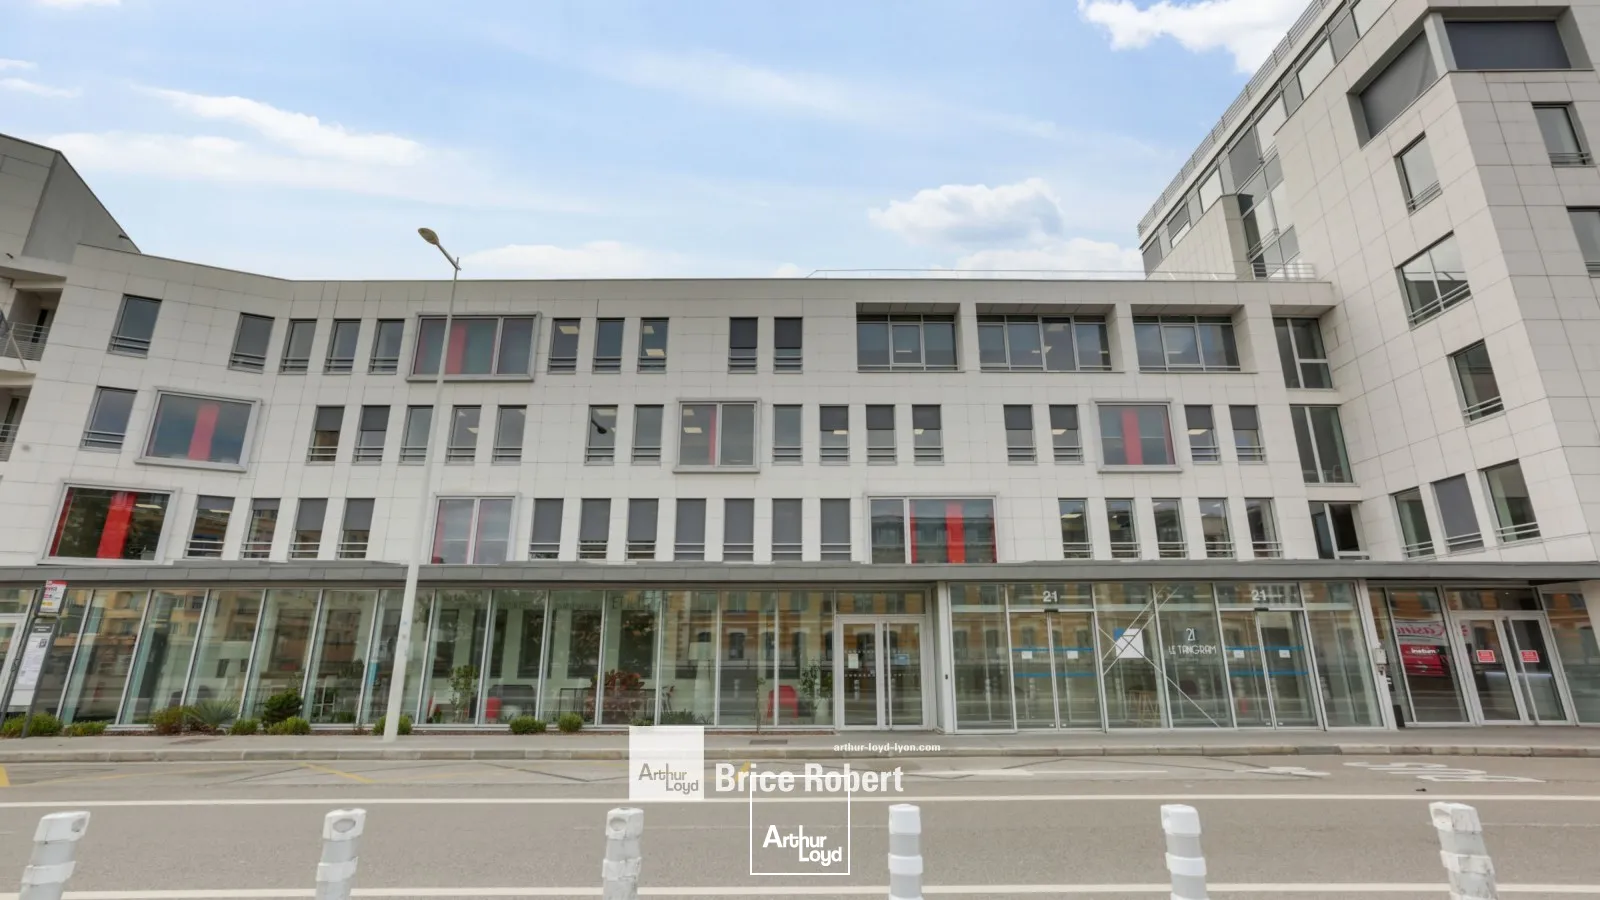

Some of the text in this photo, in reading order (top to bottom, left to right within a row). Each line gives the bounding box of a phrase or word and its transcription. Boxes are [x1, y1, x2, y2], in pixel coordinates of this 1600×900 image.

[1042, 590, 1058, 603] 21
[1252, 589, 1266, 601] 21
[1185, 627, 1196, 641] 21
[1168, 644, 1217, 655] LE TANGRAM
